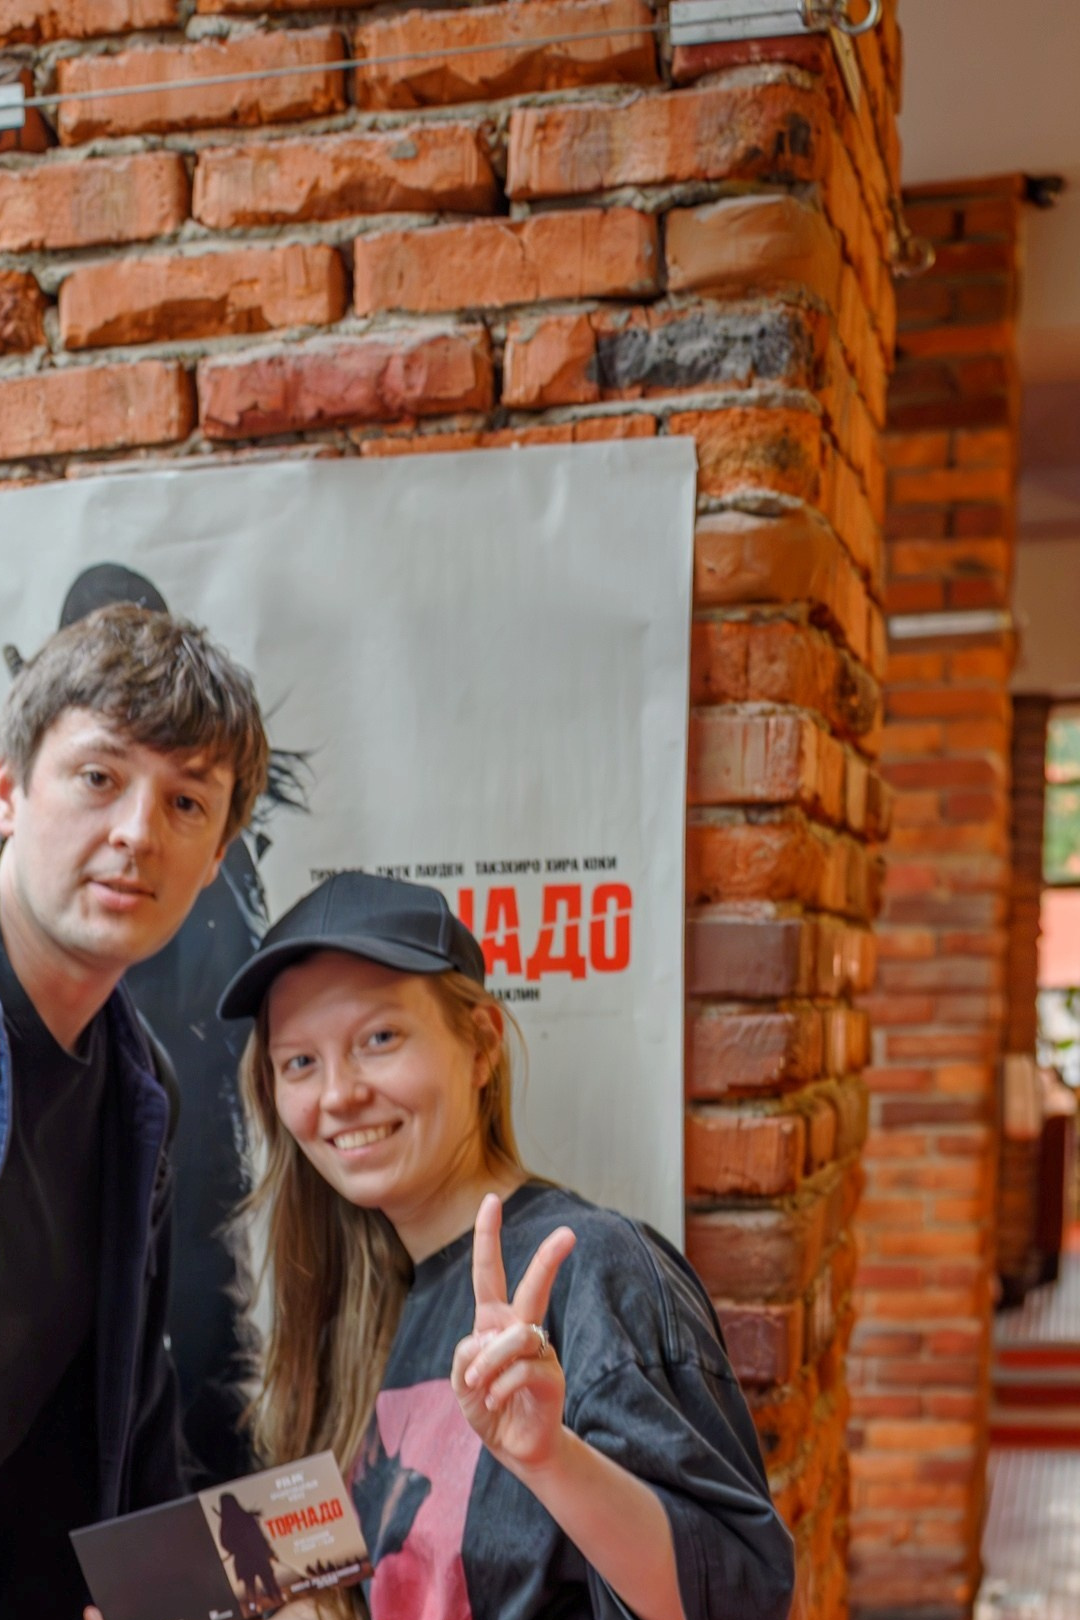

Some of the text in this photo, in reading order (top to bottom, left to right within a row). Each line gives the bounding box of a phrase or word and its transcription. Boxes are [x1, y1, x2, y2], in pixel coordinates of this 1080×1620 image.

[583, 853, 618, 871] КОКИ
[458, 883, 632, 981] АДО
[266, 1498, 343, 1539] ТОРНАДО
